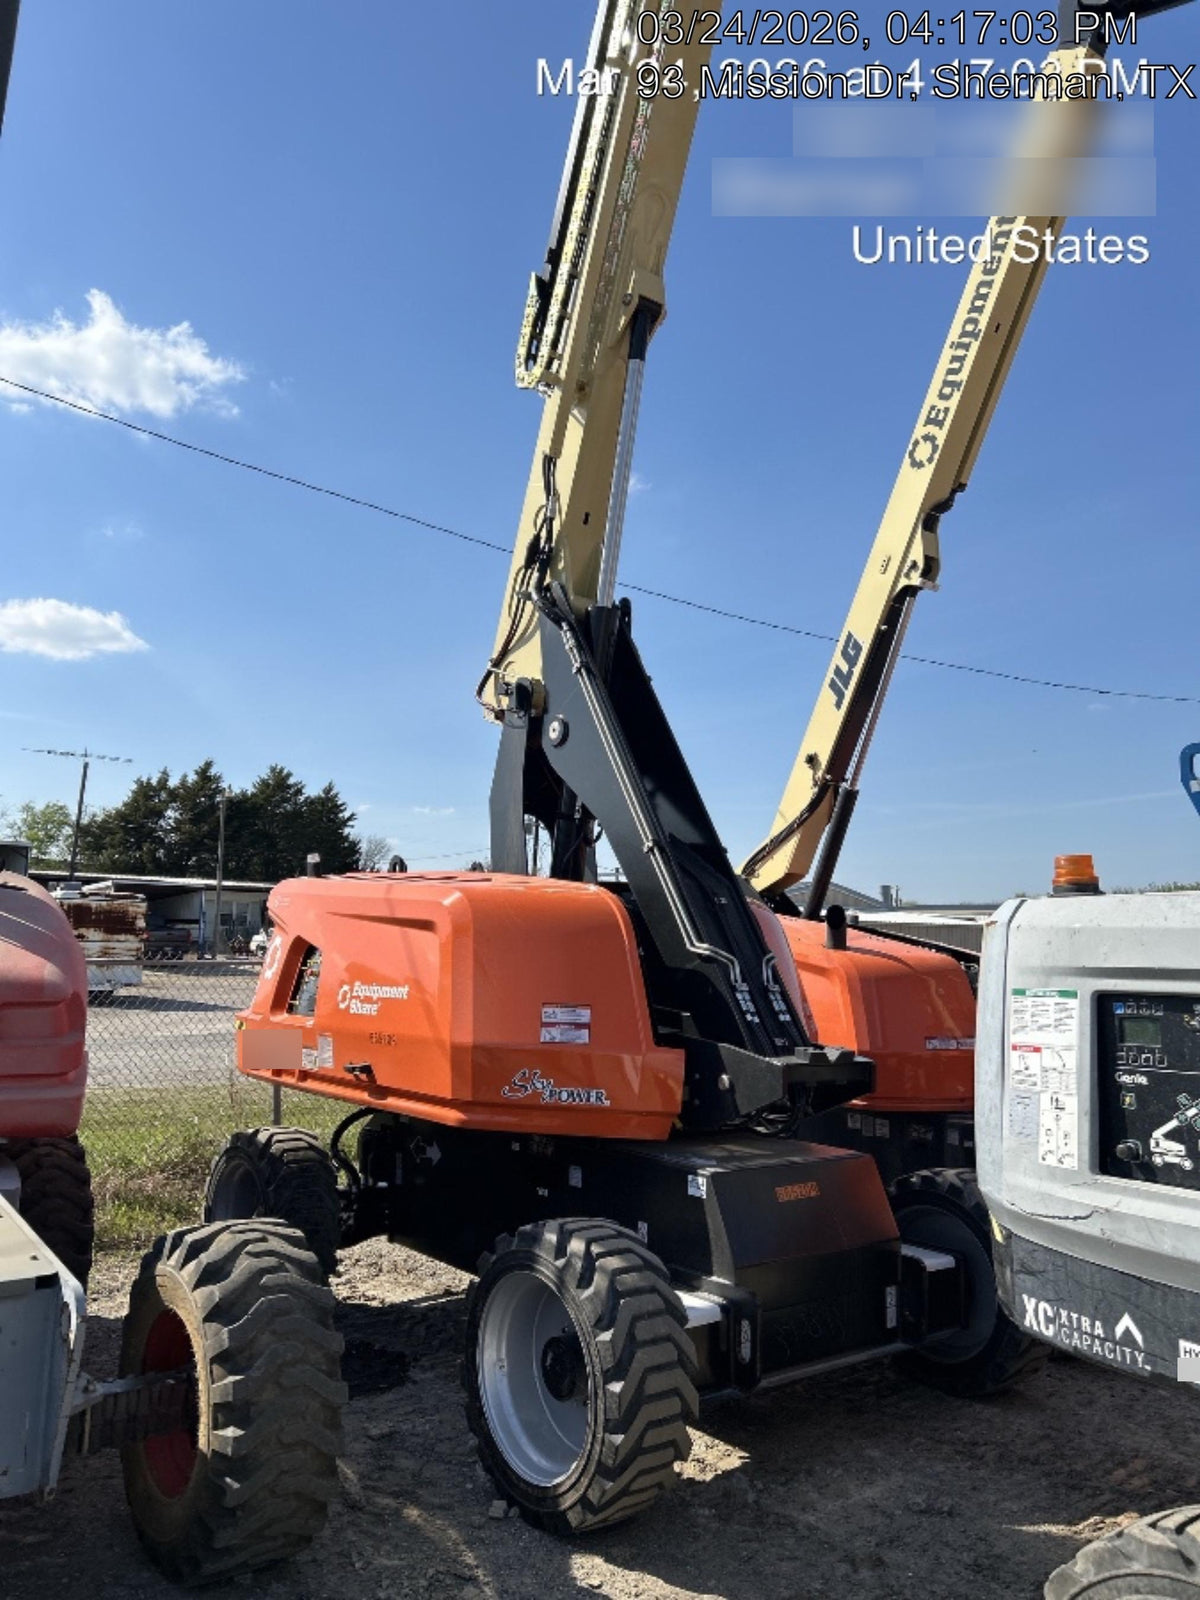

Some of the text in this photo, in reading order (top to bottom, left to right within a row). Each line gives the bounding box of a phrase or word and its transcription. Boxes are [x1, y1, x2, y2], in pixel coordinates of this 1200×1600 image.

[827, 630, 863, 712] JLG
[351, 980, 409, 1001] Equipment
[348, 998, 379, 1016] Share
[1114, 1071, 1149, 1086] Genie
[546, 1087, 607, 1106] POWER
[1021, 1293, 1055, 1337] XC
[1059, 1307, 1105, 1339] XTRA
[1060, 1327, 1146, 1369] CAPACITY
